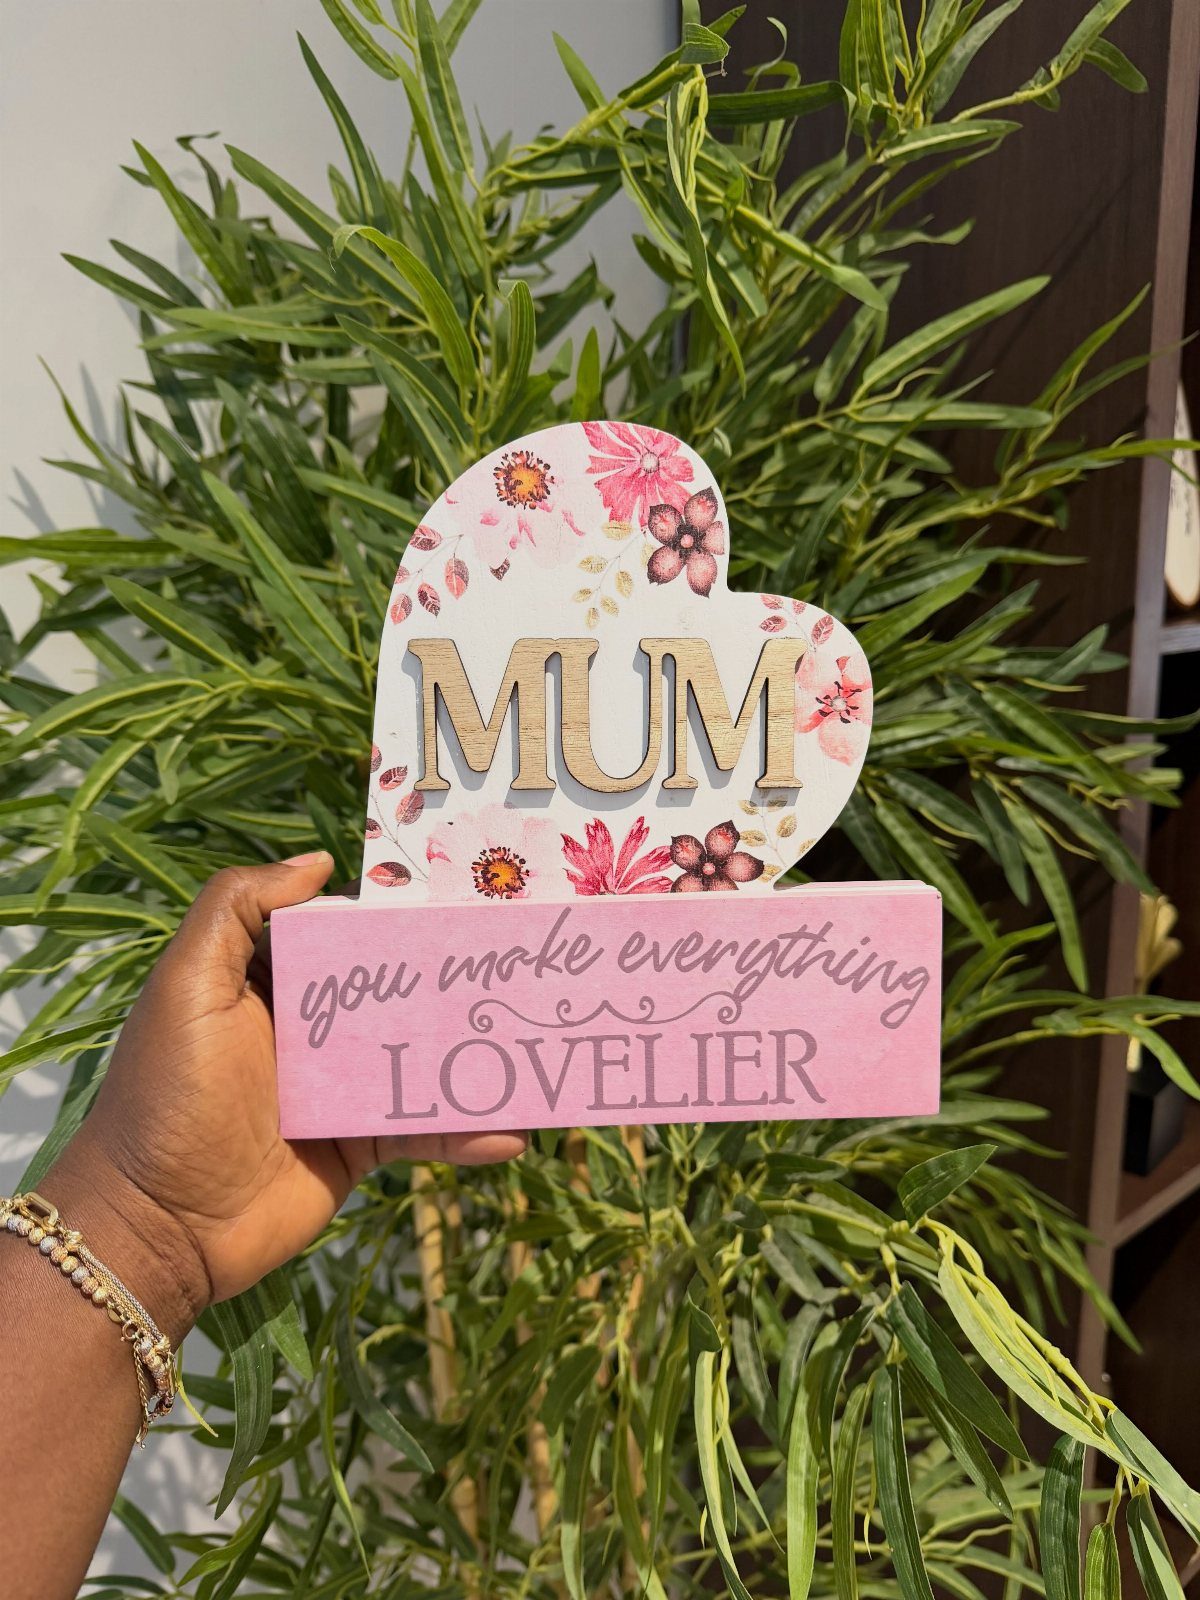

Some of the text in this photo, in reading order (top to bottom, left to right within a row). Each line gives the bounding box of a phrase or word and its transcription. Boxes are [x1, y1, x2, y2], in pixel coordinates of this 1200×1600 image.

[407, 638, 804, 793] MUM
[300, 906, 932, 1049] you make everything
[381, 1028, 826, 1120] LOVELIER
